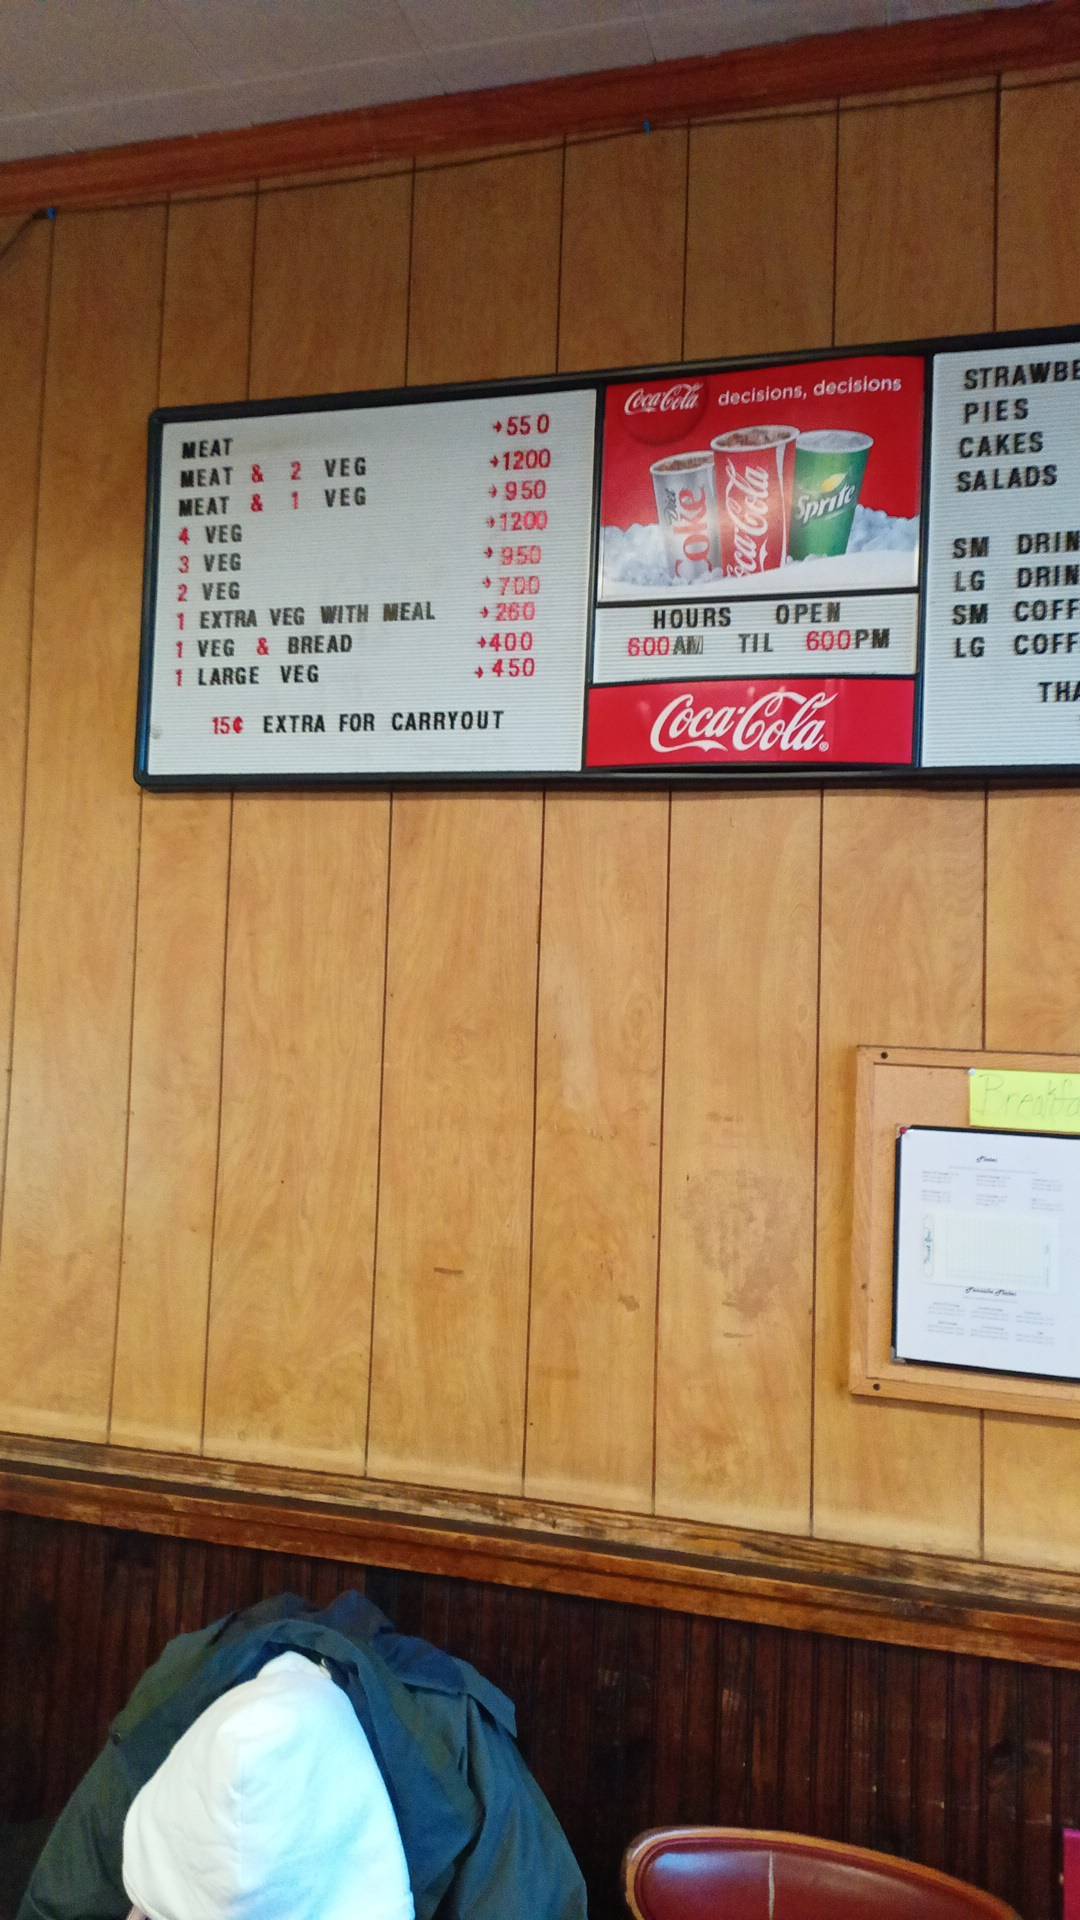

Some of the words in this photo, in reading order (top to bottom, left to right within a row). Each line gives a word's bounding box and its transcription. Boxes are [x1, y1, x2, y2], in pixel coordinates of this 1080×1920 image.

[623, 383, 704, 415] Coca-Cola
[718, 384, 808, 407] decisions,
[813, 376, 902, 397] decisions
[964, 398, 1029, 424] PIES
[507, 414, 550, 436] 550
[182, 438, 234, 459] MEAT
[959, 431, 1044, 459] CAKES
[503, 448, 551, 471] 1200
[180, 466, 234, 488] MEAT
[251, 464, 264, 483] &
[291, 461, 301, 480] 2
[324, 457, 366, 478] VEG
[957, 464, 1057, 492] SALADS
[178, 496, 230, 517] MEAT
[251, 494, 263, 512] &
[292, 491, 299, 509] 1
[324, 487, 366, 508] VEG
[505, 479, 547, 501] 950
[797, 482, 856, 525] Sprite
[178, 528, 190, 544] 4
[205, 524, 243, 544] VEG
[500, 511, 548, 532] 1200
[952, 536, 989, 559] SM
[1017, 531, 1080, 555] DRIN
[178, 556, 189, 574] 3
[204, 553, 242, 572] VEG
[499, 575, 541, 596] 700
[955, 569, 985, 592] LG
[1017, 564, 1080, 588] DRIN
[177, 583, 188, 602] 2
[202, 582, 241, 601] VEG
[177, 612, 184, 631] 1
[199, 609, 258, 629] EXTRA
[269, 607, 306, 626] VEG
[320, 604, 369, 625] WITH
[383, 601, 436, 622] MEAL
[653, 606, 731, 629] HOURS
[775, 601, 841, 625] OPEN
[952, 603, 988, 625] SM
[1014, 598, 1080, 622] COFF
[176, 641, 183, 659] 1
[197, 639, 235, 658] VEG
[256, 637, 270, 656] &
[288, 634, 353, 655] BREAD
[489, 631, 533, 652] 400
[738, 632, 774, 654] TIL
[955, 636, 985, 658] LG
[1014, 632, 1080, 656] COFF
[176, 669, 182, 687] 1
[198, 666, 260, 687] LARGE
[280, 664, 319, 684] VEG
[492, 658, 535, 678] 450
[263, 714, 326, 733] EXTRA
[339, 713, 375, 732] FOR
[391, 710, 504, 731] CARRYOUT
[649, 691, 839, 752] Coca-Cola
